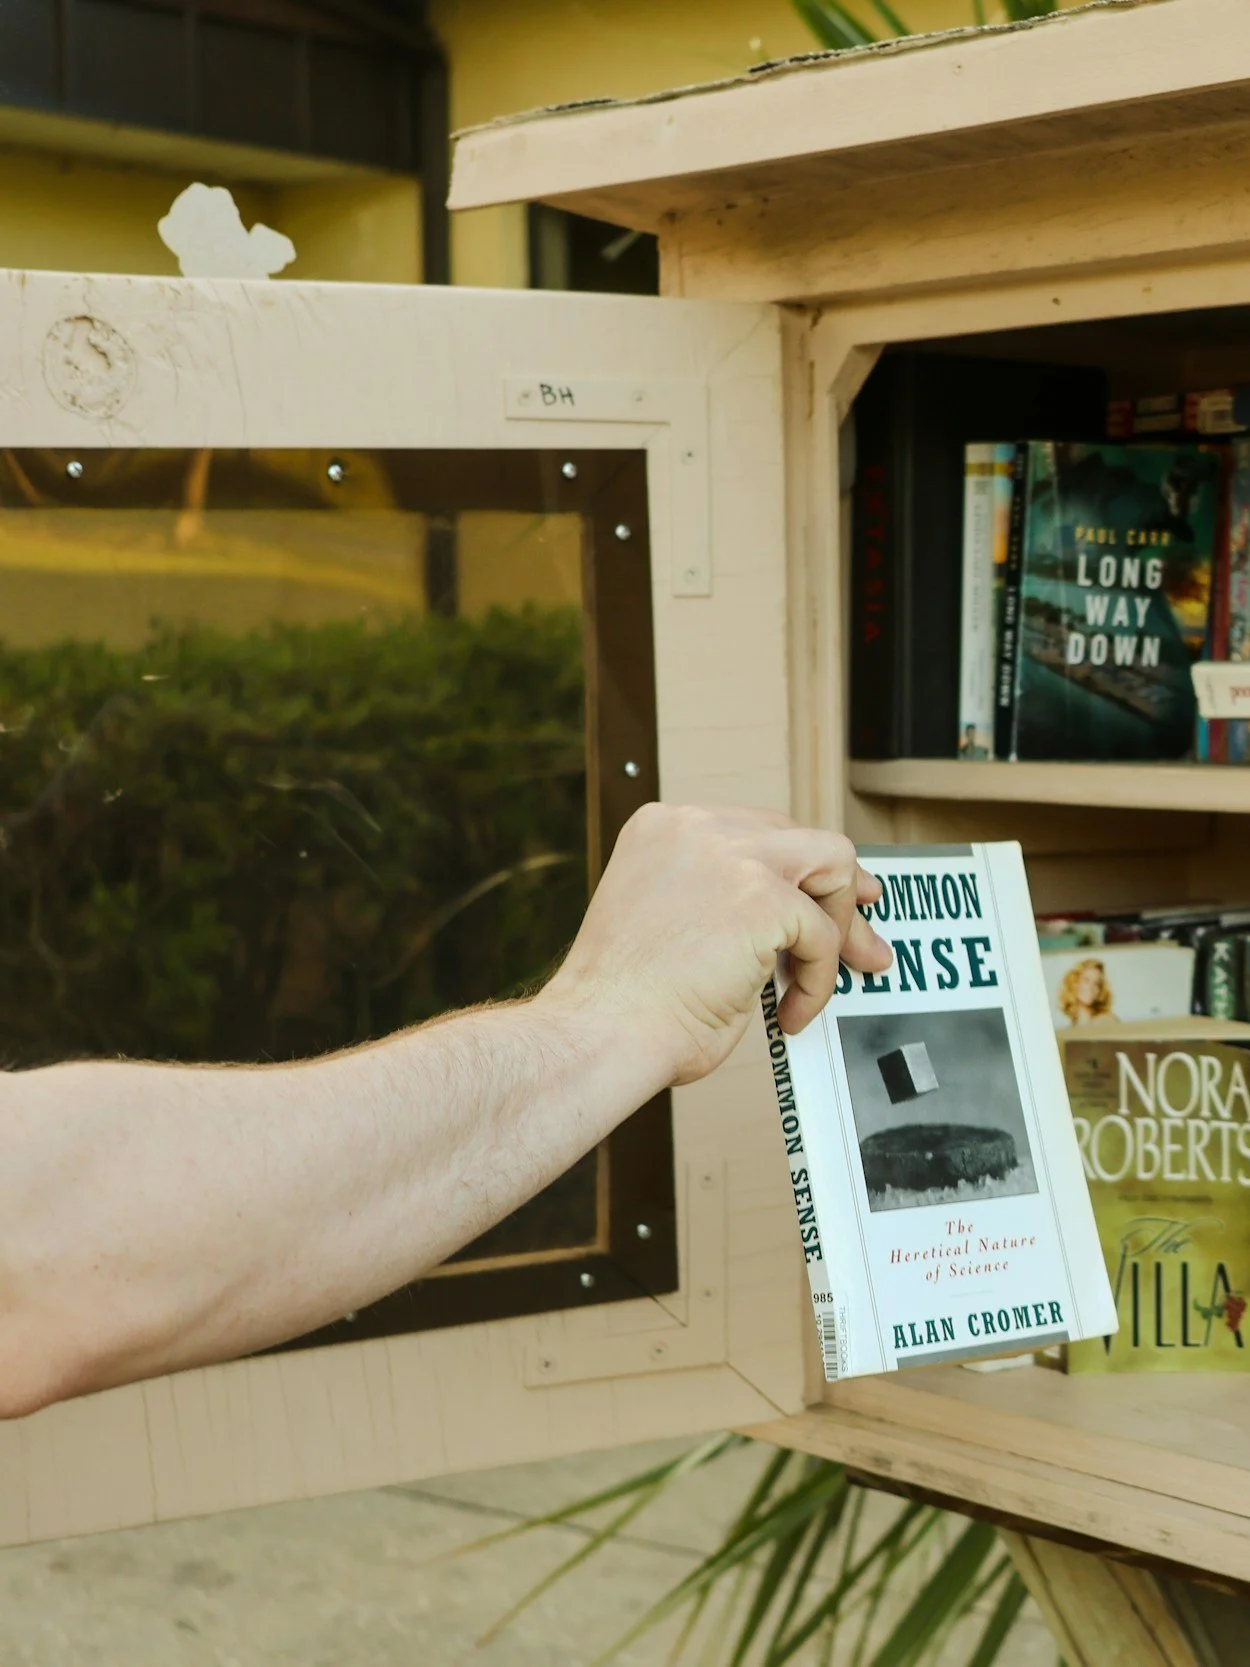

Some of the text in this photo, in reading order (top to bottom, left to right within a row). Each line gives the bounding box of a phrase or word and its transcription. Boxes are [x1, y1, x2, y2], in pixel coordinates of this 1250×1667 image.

[539, 382, 575, 407] BH
[1074, 526, 1171, 547] PAUL CARR
[1077, 554, 1164, 590] LONG
[1085, 595, 1151, 628] WAY
[1066, 633, 1161, 667] DOWN
[857, 873, 982, 922] OMMON
[761, 978, 823, 1264] UNCOMMON SENSE
[945, 1219, 974, 1236] The
[1121, 1216, 1205, 1256] The
[890, 1235, 1036, 1264] Heretical Nature
[925, 1260, 1009, 1285] of Science
[813, 1292, 834, 1304] 985
[1103, 1243, 1245, 1355] VILLA
[839, 1305, 849, 1373] THRIFTBOOKS
[893, 1300, 1064, 1350] ALAN CROMER
